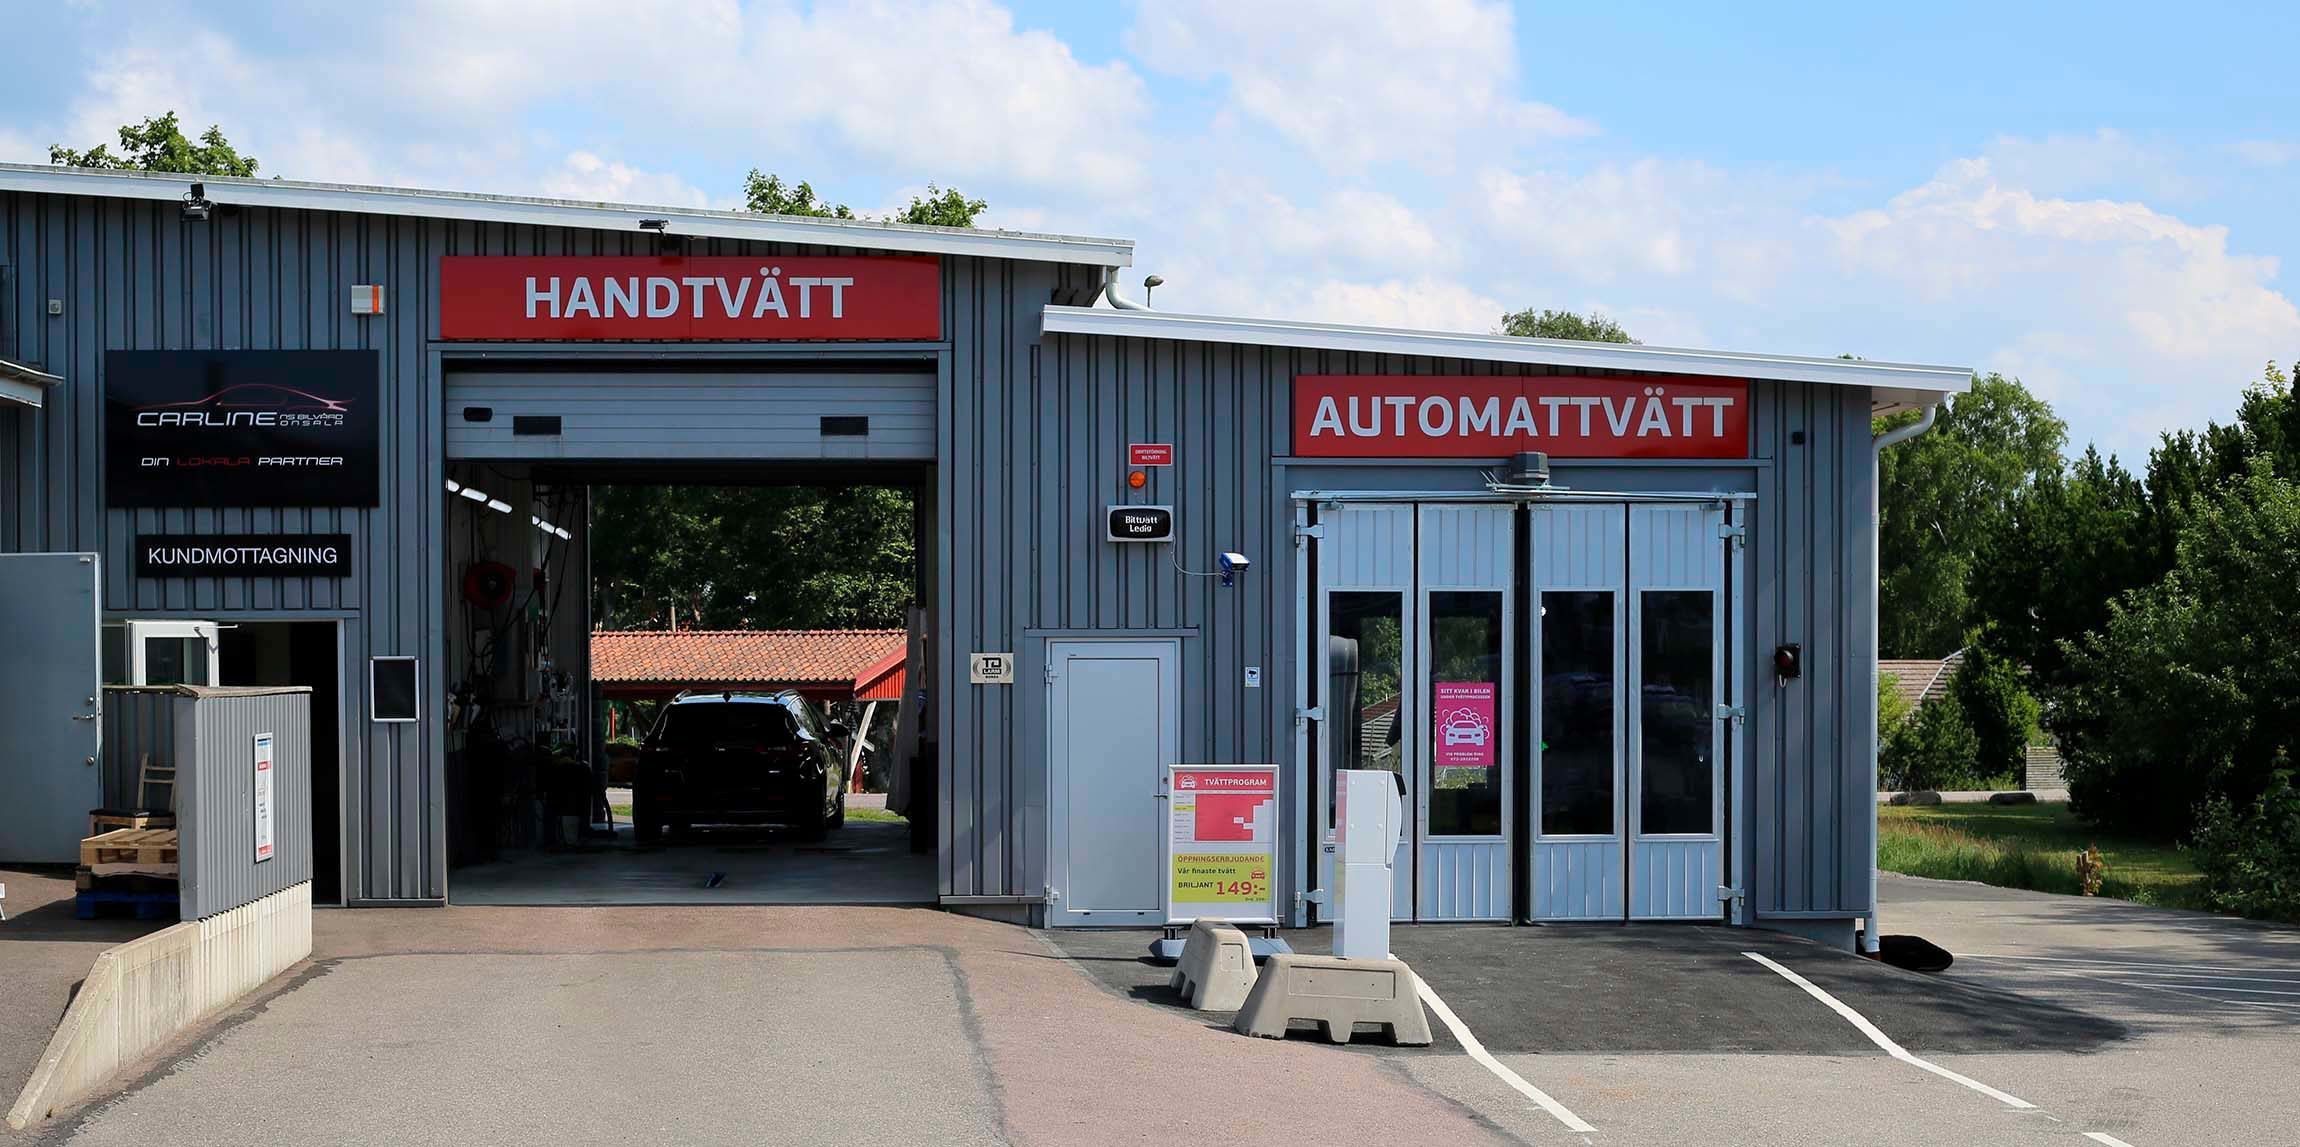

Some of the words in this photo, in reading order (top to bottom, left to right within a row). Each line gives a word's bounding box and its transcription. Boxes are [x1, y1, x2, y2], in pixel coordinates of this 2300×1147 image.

[525, 266, 854, 319] HANDTVÄTT
[137, 411, 278, 427] CARLINE
[1309, 386, 1735, 438] AUTOMATTVÄTT
[141, 457, 170, 467] DIN
[176, 457, 251, 466] LOKALA
[258, 456, 344, 466] PARTNER
[148, 547, 338, 565] KUNDMOTTAGNING
[1204, 777, 1267, 786] TVÄTTPROGRAM
[1177, 855, 1265, 863] ÖPPNINGSERBJUDANDE
[1178, 881, 1214, 889] BRILJANT
[1216, 880, 1266, 895] 149:-
